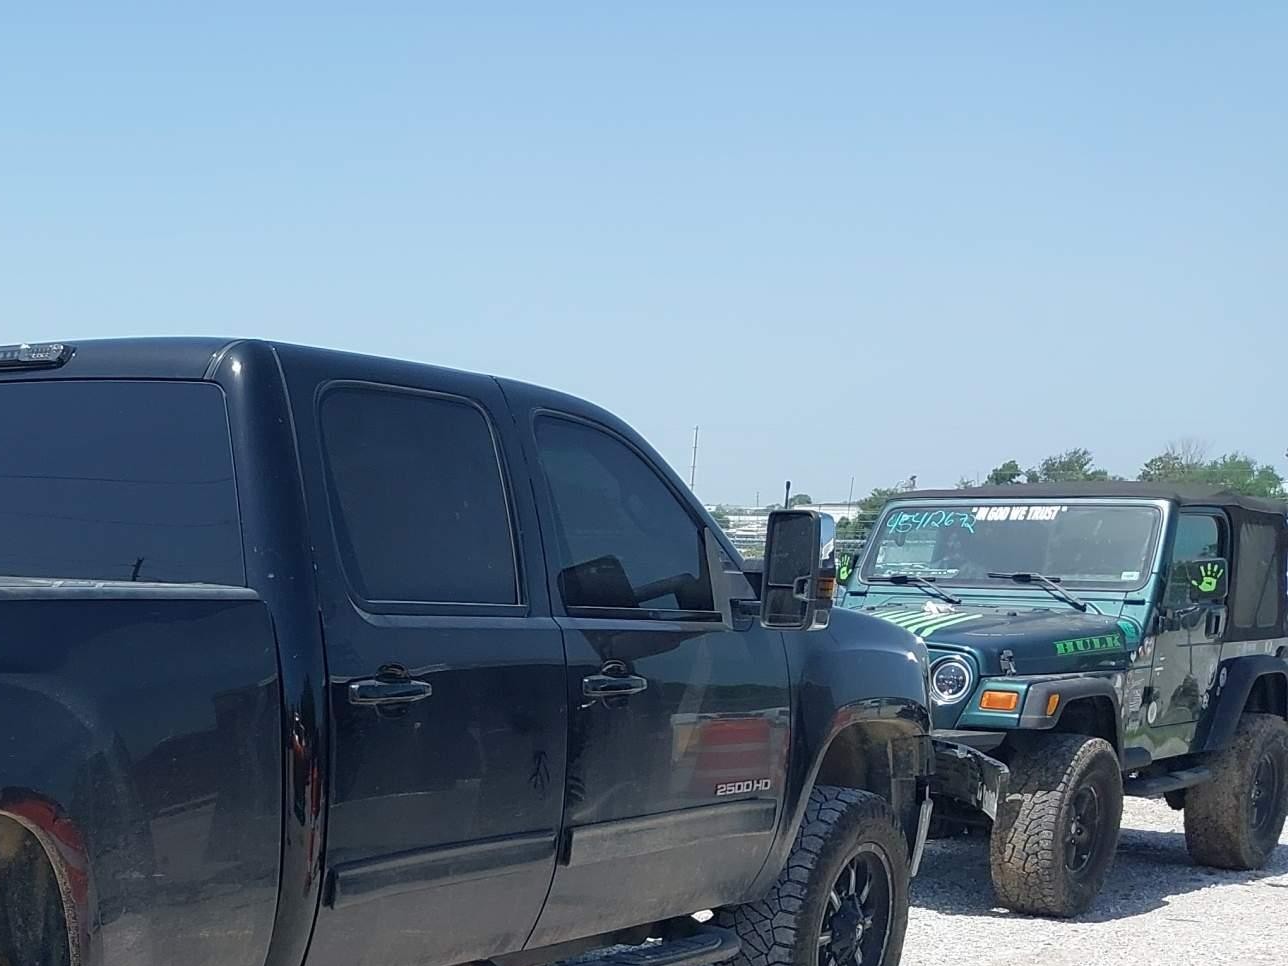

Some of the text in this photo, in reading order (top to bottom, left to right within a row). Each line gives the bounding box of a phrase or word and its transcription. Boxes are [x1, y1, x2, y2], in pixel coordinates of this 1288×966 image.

[988, 506, 1010, 521] GOD
[1009, 506, 1028, 521] WE
[1054, 633, 1121, 655] HULK
